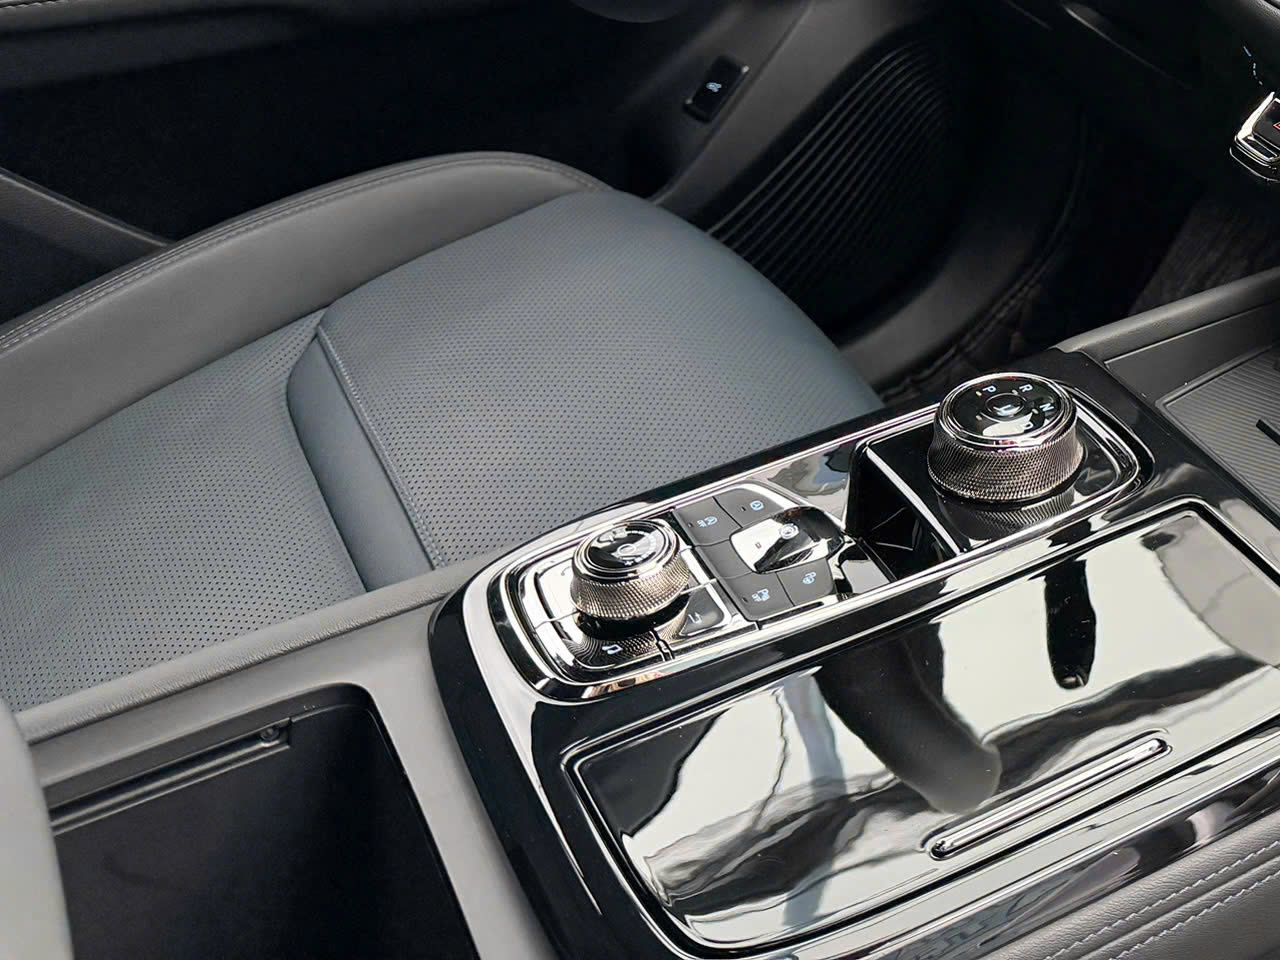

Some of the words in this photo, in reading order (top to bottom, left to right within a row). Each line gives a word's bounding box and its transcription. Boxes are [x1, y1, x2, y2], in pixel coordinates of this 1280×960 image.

[982, 385, 997, 393] P
[1019, 383, 1033, 392] R
[1039, 402, 1054, 412] N
